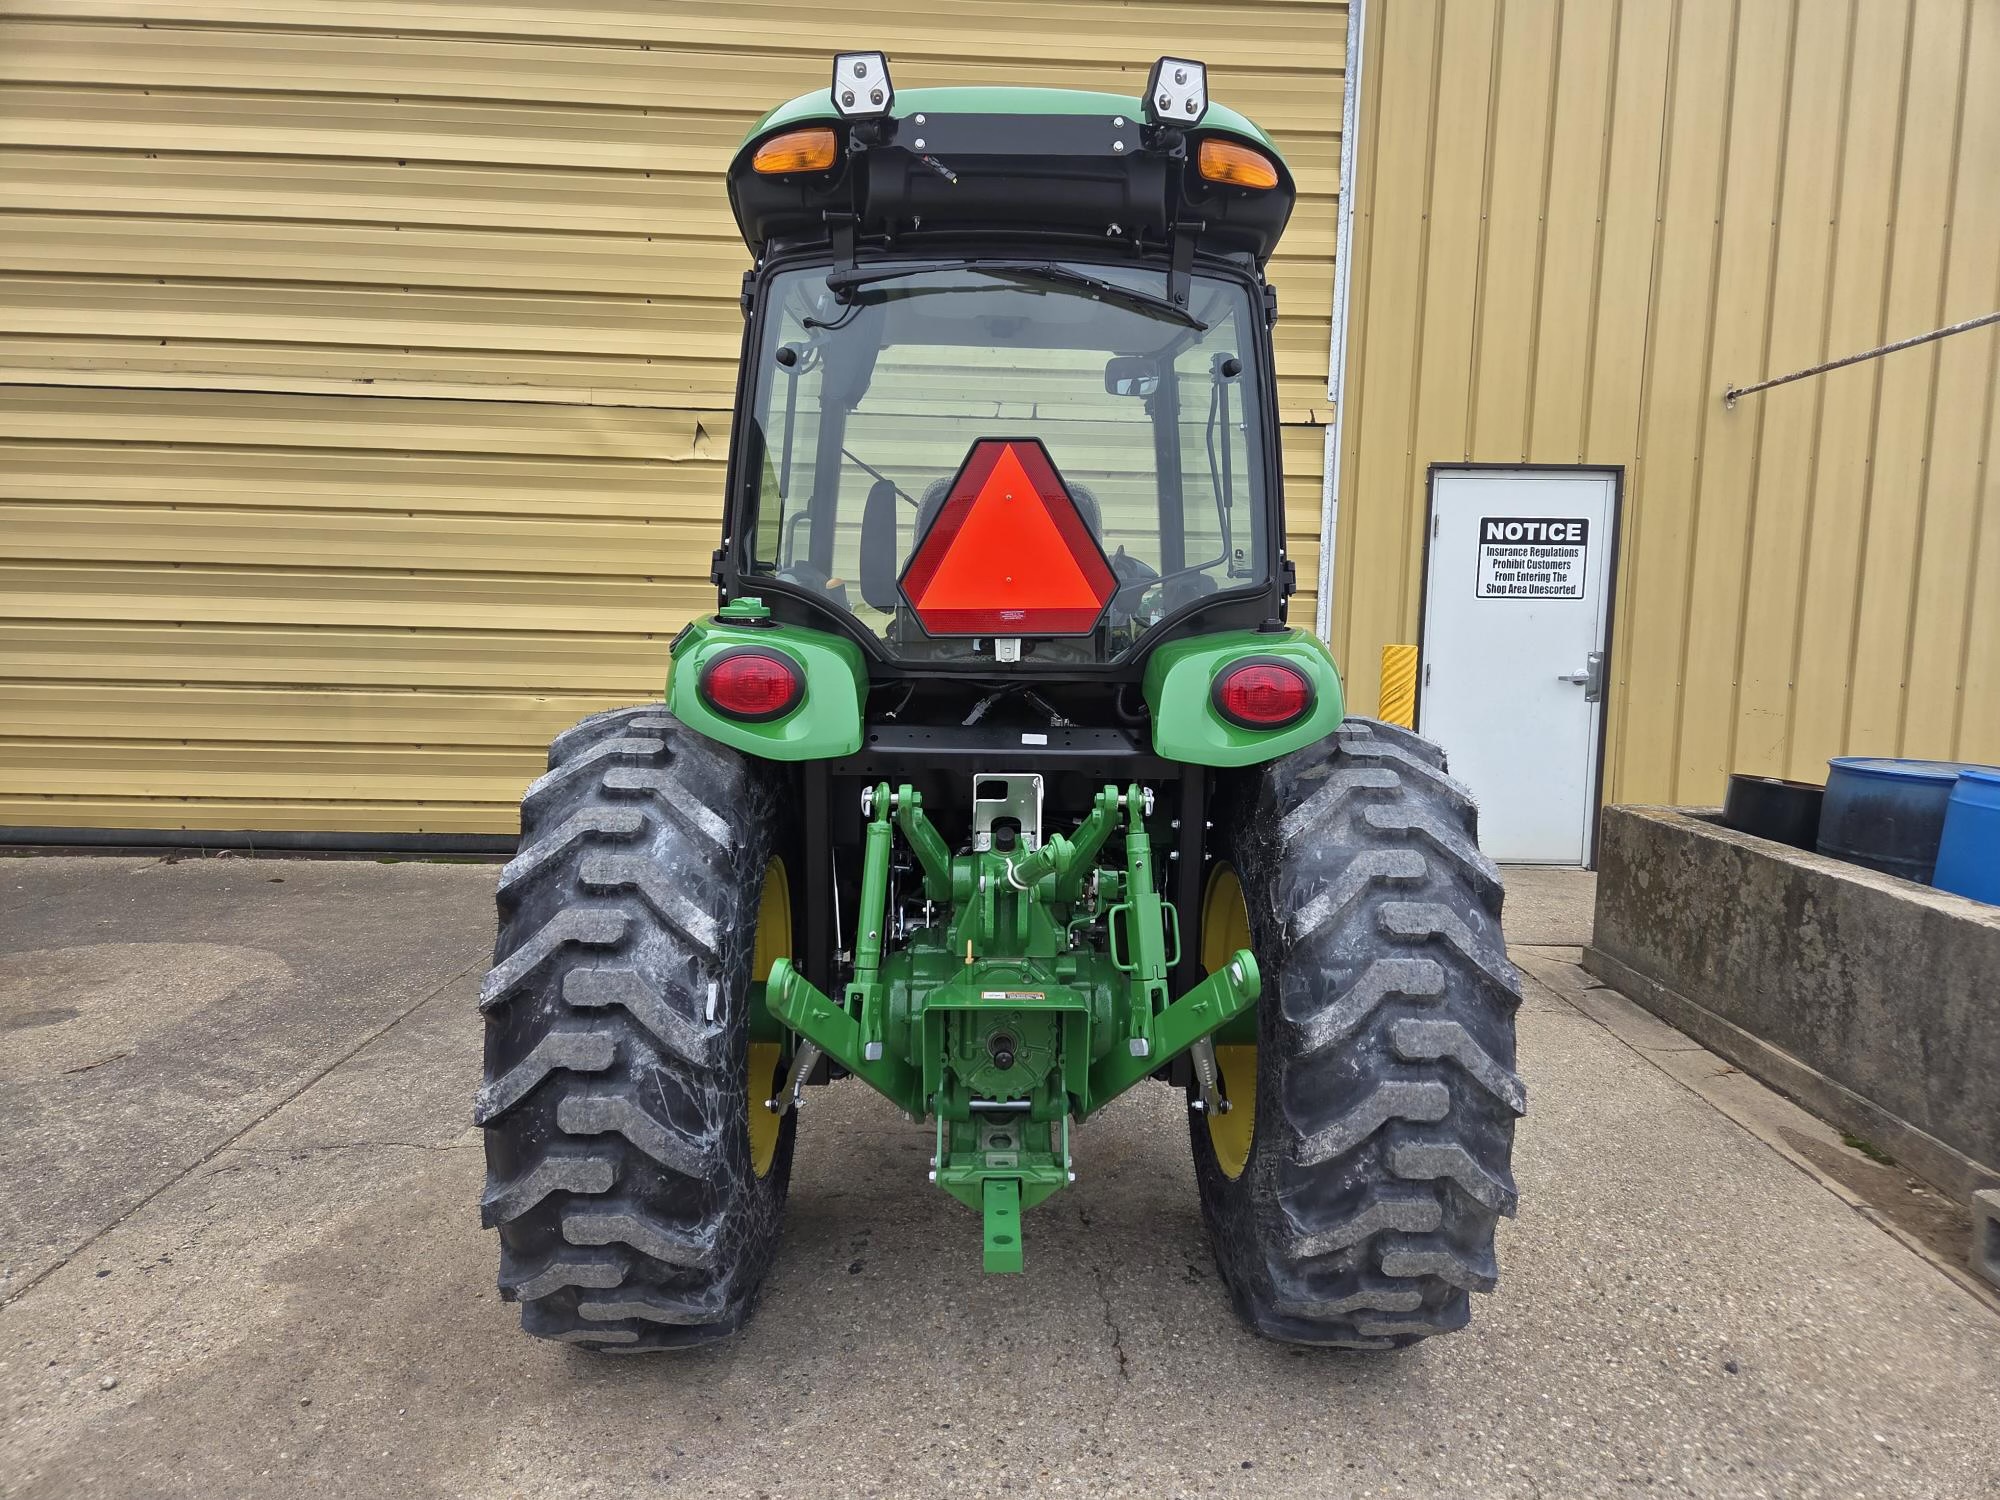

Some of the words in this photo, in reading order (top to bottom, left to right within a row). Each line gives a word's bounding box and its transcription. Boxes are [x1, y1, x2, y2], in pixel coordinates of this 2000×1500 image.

[1487, 522, 1581, 540] NOTICE
[1487, 546, 1528, 556] Insurance
[1530, 547, 1579, 558] Regulations
[1493, 559, 1525, 569] Prohibit
[1527, 560, 1571, 569] Customers
[1495, 571, 1515, 581] From
[1517, 572, 1550, 583] Entering
[1553, 572, 1567, 582] The
[1486, 584, 1506, 594] Shop
[1508, 584, 1527, 594] Area
[1529, 584, 1576, 594] Unescorted
